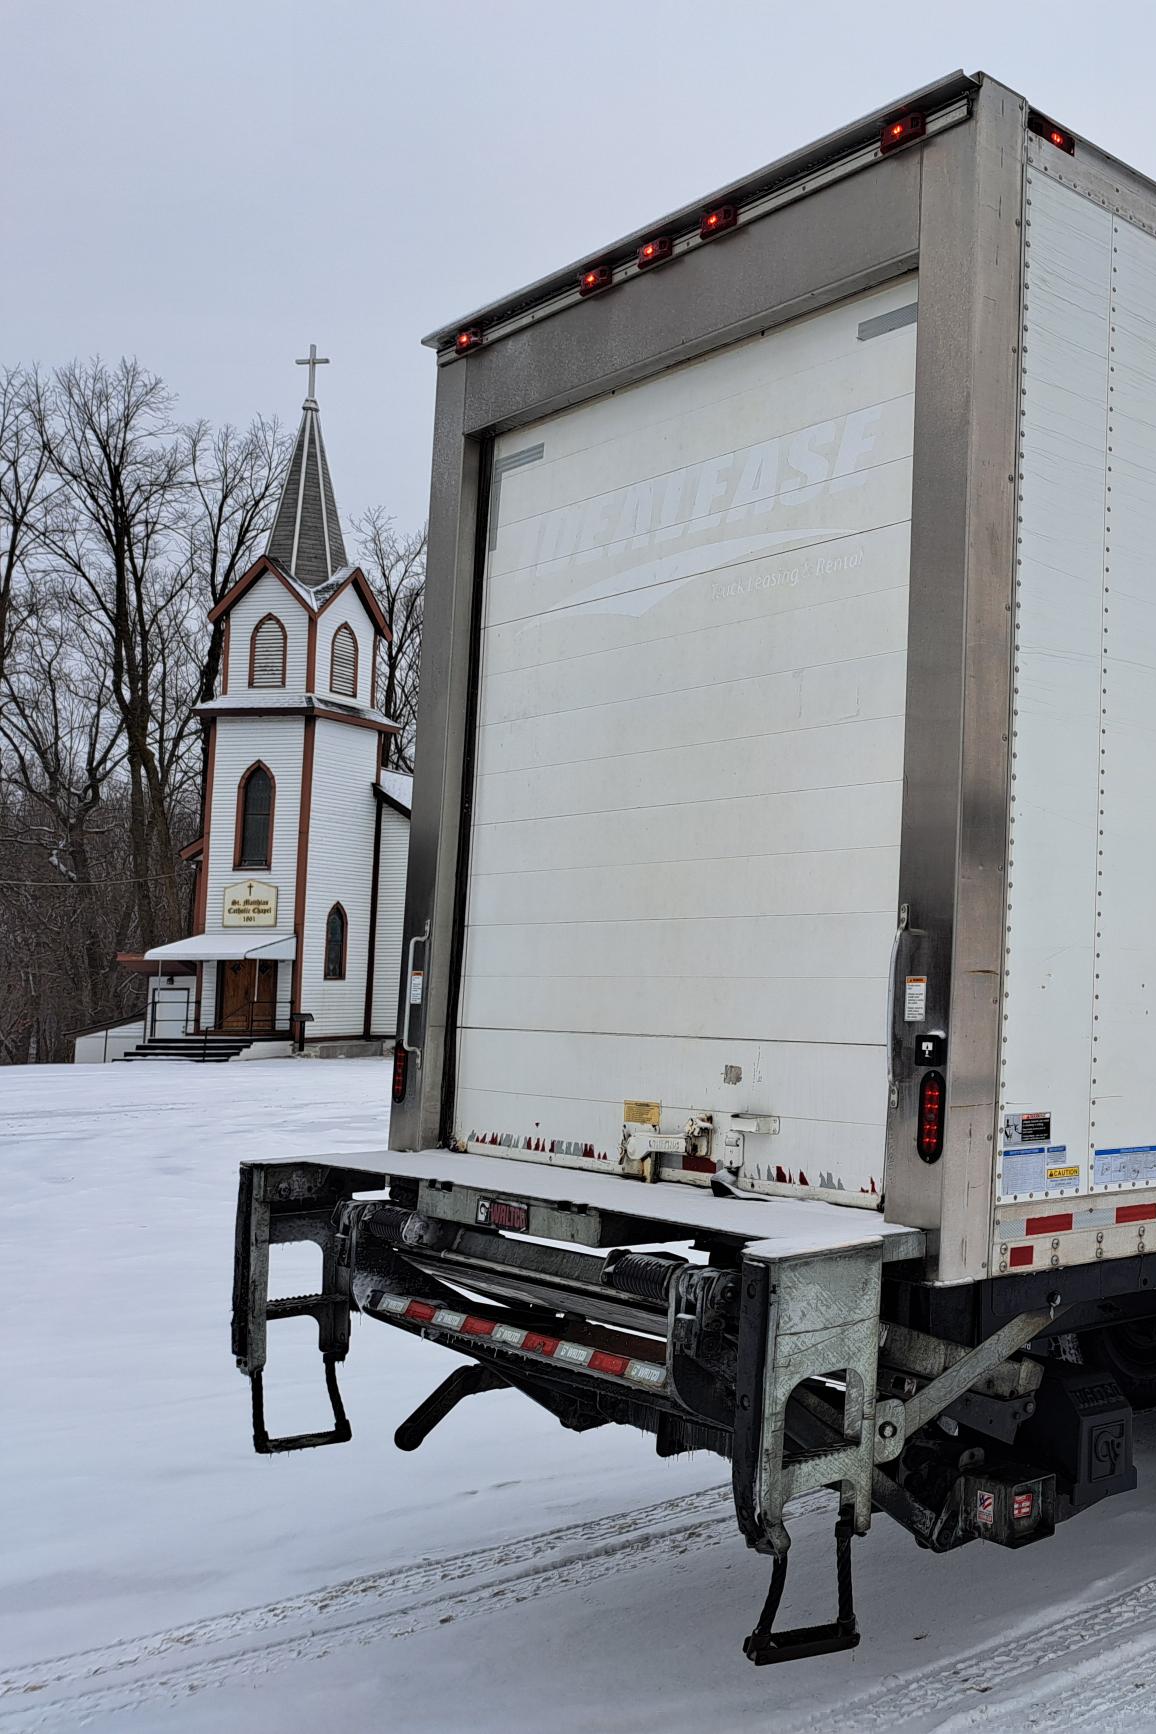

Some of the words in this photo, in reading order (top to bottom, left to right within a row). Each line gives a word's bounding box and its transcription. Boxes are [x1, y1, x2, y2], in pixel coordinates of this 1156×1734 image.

[815, 547, 865, 577] Rental
[252, 907, 272, 915] Chapel
[1053, 1168, 1078, 1177] CAUTION
[491, 1203, 527, 1228] WALTCO
